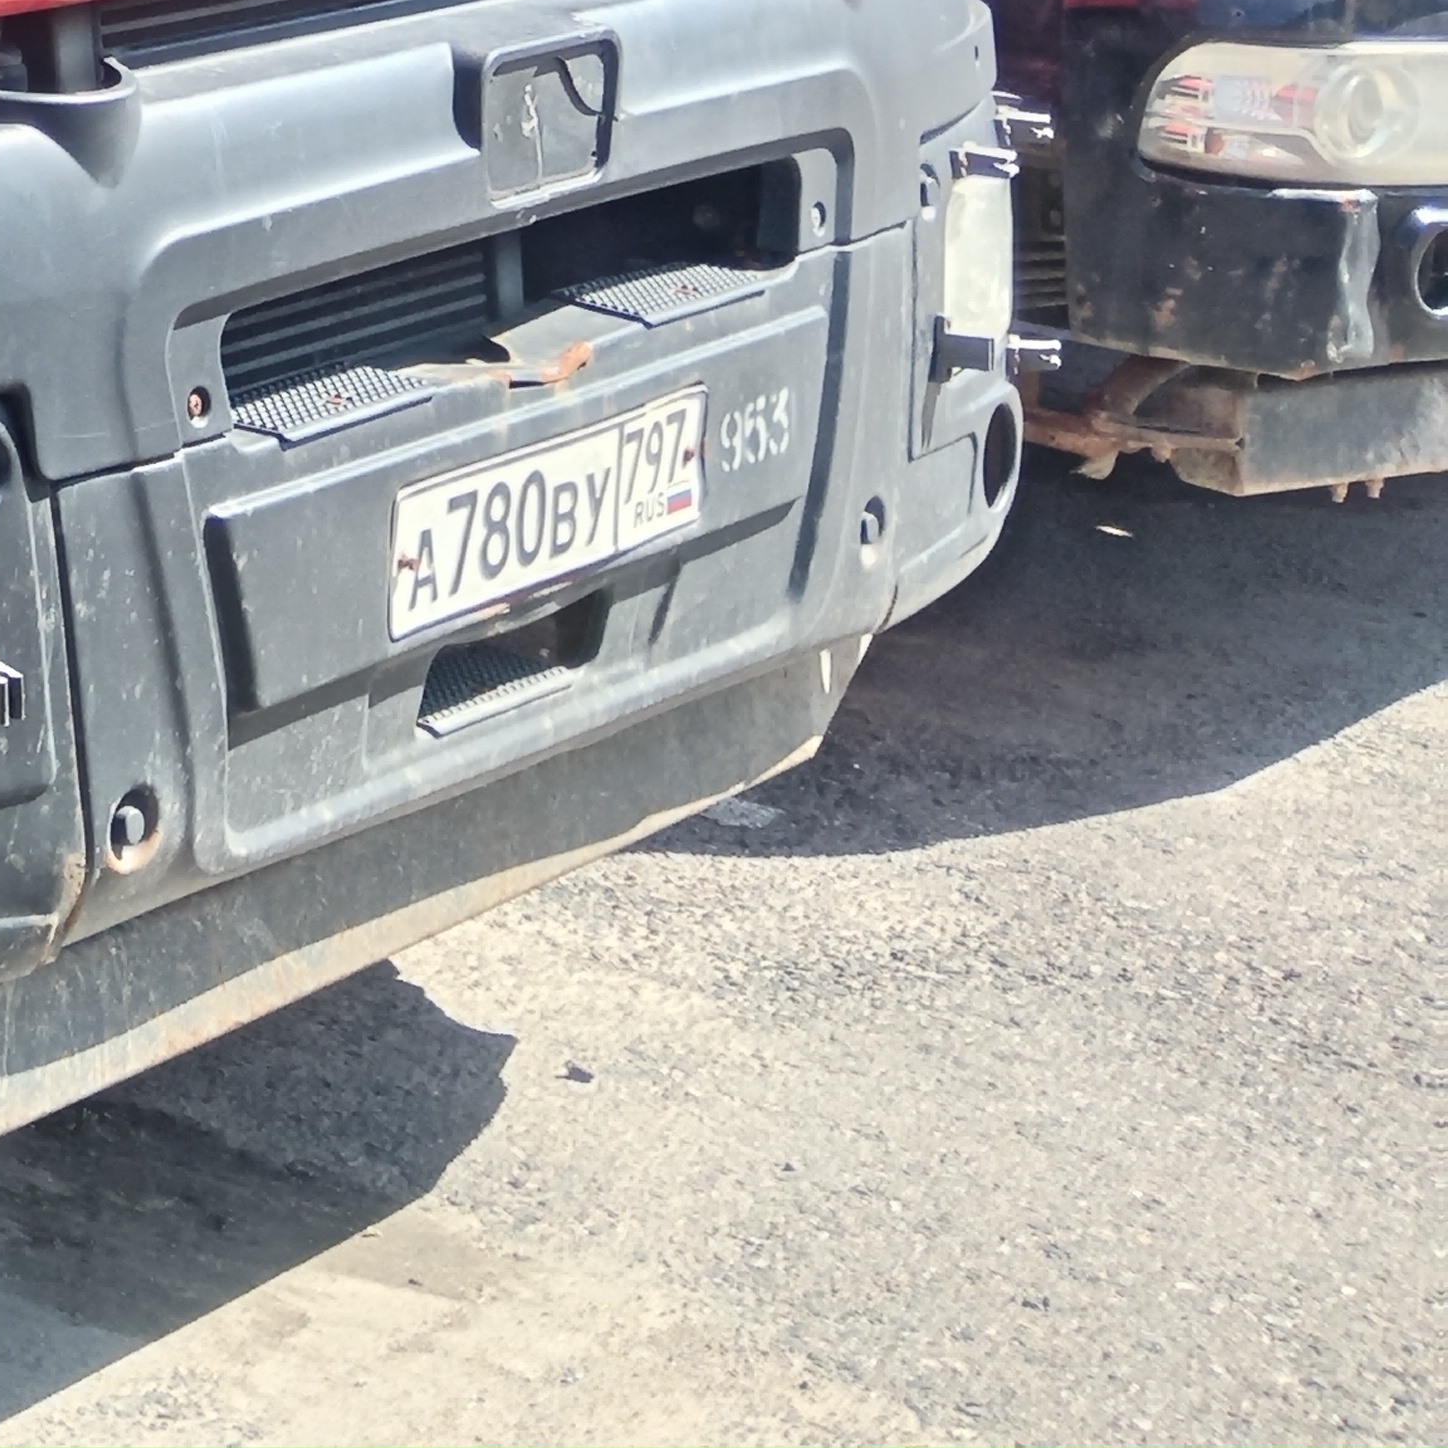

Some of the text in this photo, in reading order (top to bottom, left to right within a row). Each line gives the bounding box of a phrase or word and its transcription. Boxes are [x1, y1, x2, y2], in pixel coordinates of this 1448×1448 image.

[623, 407, 687, 505] 797
[720, 385, 790, 473] 953
[633, 491, 665, 529] RUS
